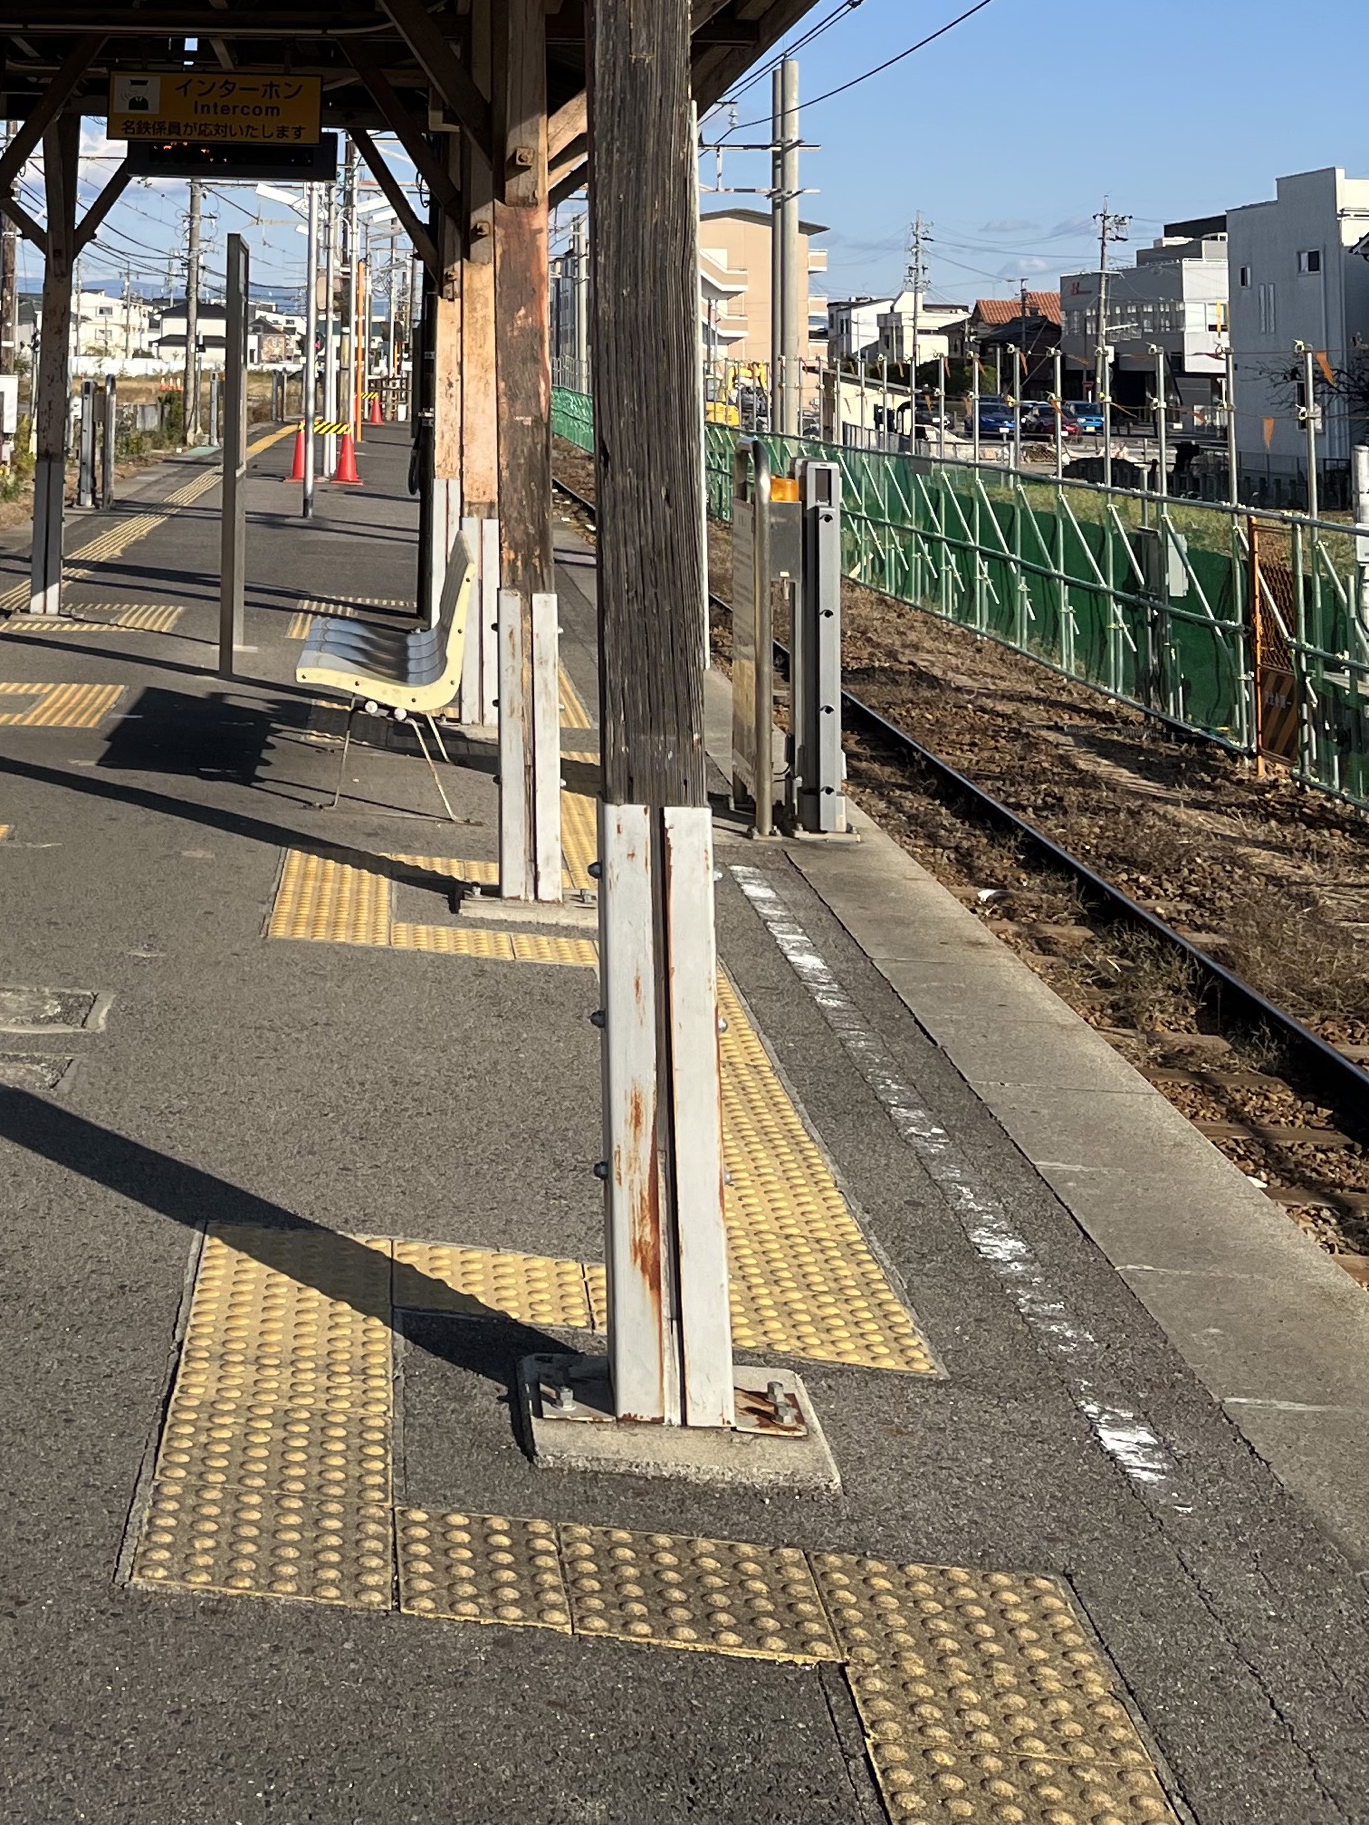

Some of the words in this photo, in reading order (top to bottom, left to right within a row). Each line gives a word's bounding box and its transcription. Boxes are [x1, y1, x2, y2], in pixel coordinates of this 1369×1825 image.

[175, 78, 304, 100] インターホン
[193, 100, 281, 117] Intercom
[121, 119, 306, 140] 名鉄係員が応対いたします
